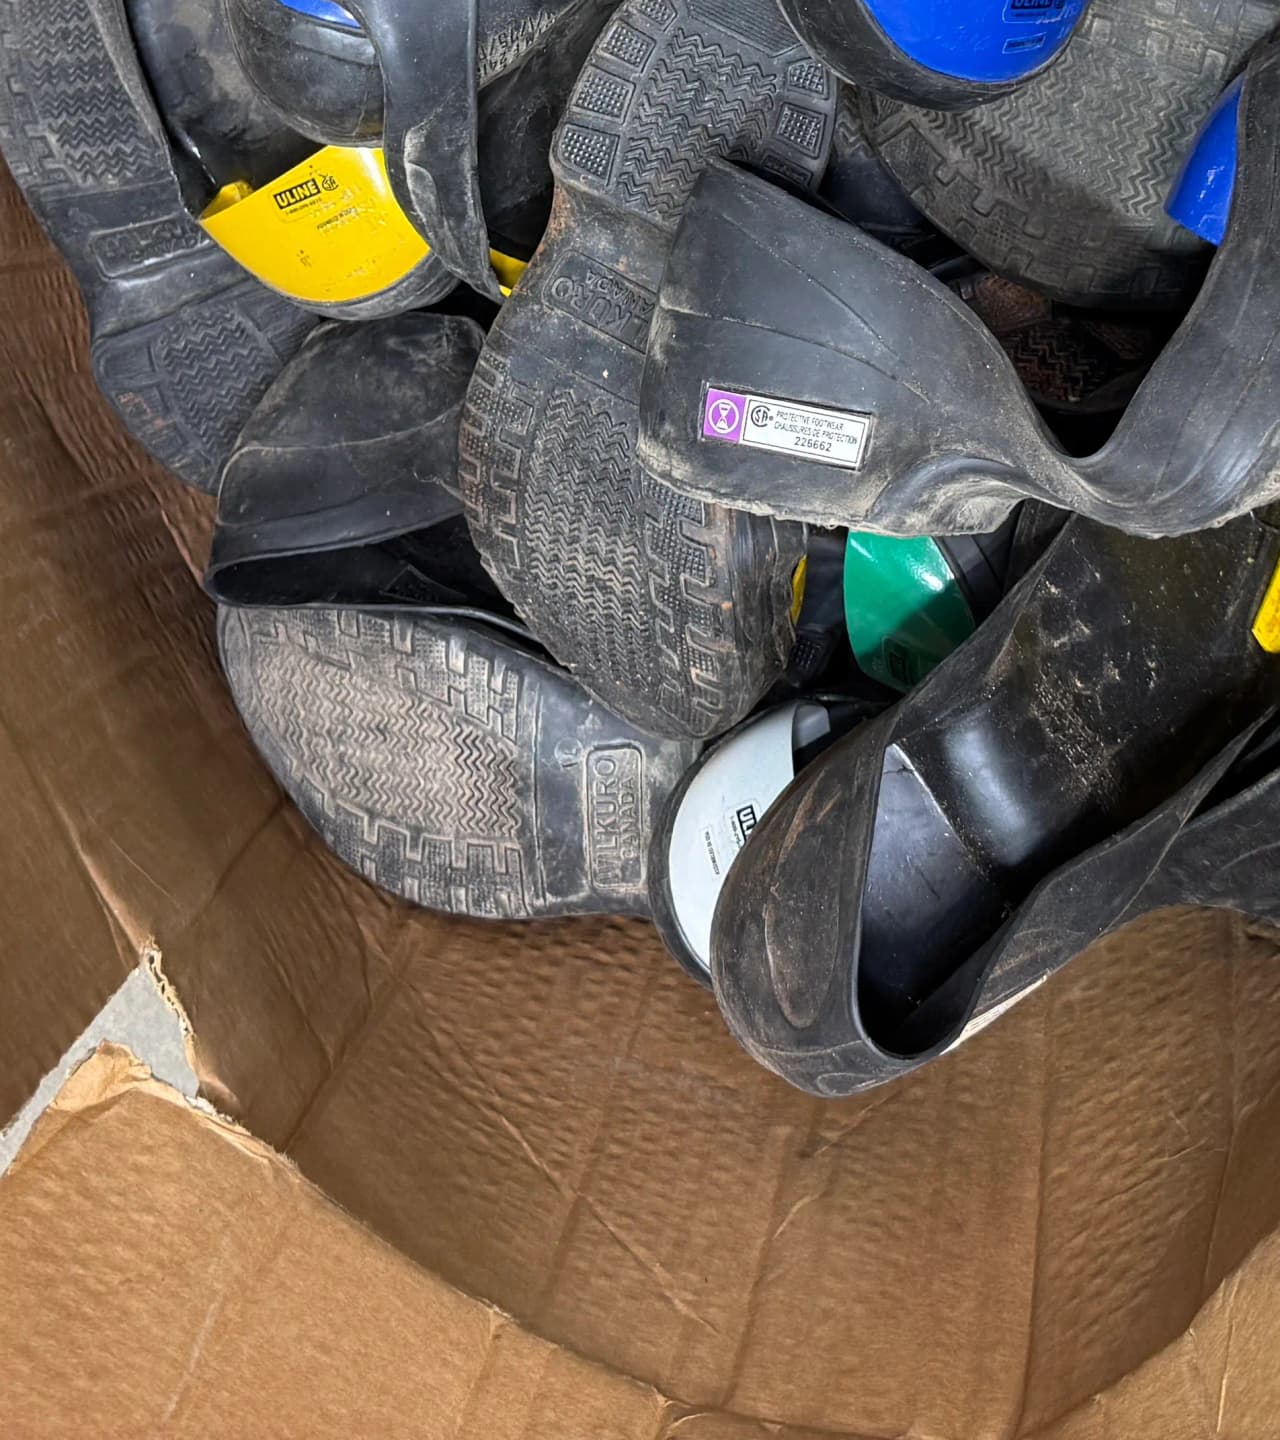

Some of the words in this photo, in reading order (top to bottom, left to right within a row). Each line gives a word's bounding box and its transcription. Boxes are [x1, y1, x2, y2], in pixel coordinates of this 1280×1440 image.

[275, 179, 320, 207] ULINE
[581, 267, 656, 317] ANADA
[773, 421, 812, 436] CHAUSSURES
[820, 430, 858, 445] PROTECTION
[775, 410, 810, 424] PROTECTIVE
[810, 417, 843, 430] FOOTWEAR
[793, 436, 832, 452] 226662
[592, 758, 621, 881] WILKURO
[619, 776, 635, 858] CANADA
